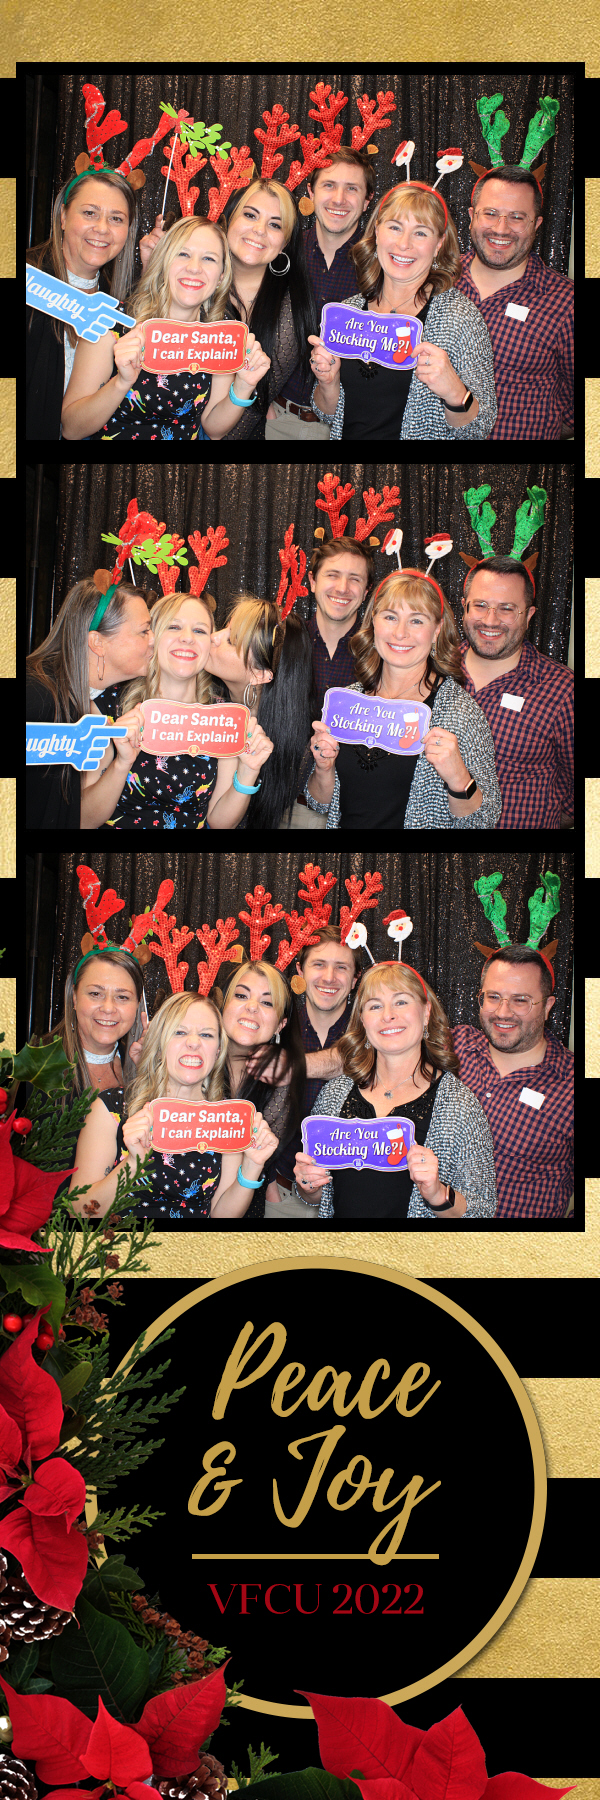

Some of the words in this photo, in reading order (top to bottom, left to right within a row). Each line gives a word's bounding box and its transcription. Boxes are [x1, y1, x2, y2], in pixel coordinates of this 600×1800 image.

[345, 317, 364, 331] Are
[367, 319, 389, 334] You
[151, 330, 188, 344] Dear
[191, 331, 237, 347] Santa,
[328, 329, 377, 353] Stocking
[380, 336, 411, 354] Me?!
[152, 348, 158, 360] I
[160, 351, 184, 360] can
[187, 348, 238, 362] Explain!
[349, 702, 370, 717] Are
[373, 705, 396, 720] You
[150, 710, 188, 725] Dear
[191, 712, 238, 730] Santa,
[330, 714, 383, 738] Stocking
[386, 722, 418, 740] Me?!
[151, 728, 157, 740] I
[159, 731, 184, 741] can
[186, 730, 239, 745] Explain!
[26, 734, 82, 758] ughty
[159, 1109, 196, 1123] Dear
[198, 1110, 244, 1125] Santa,
[161, 1127, 166, 1138] I
[168, 1130, 192, 1138] can
[195, 1127, 245, 1141] Explain!
[329, 1127, 351, 1141] Are
[354, 1127, 379, 1140] You
[313, 1142, 368, 1160] Stocking
[371, 1141, 403, 1156] Me?!
